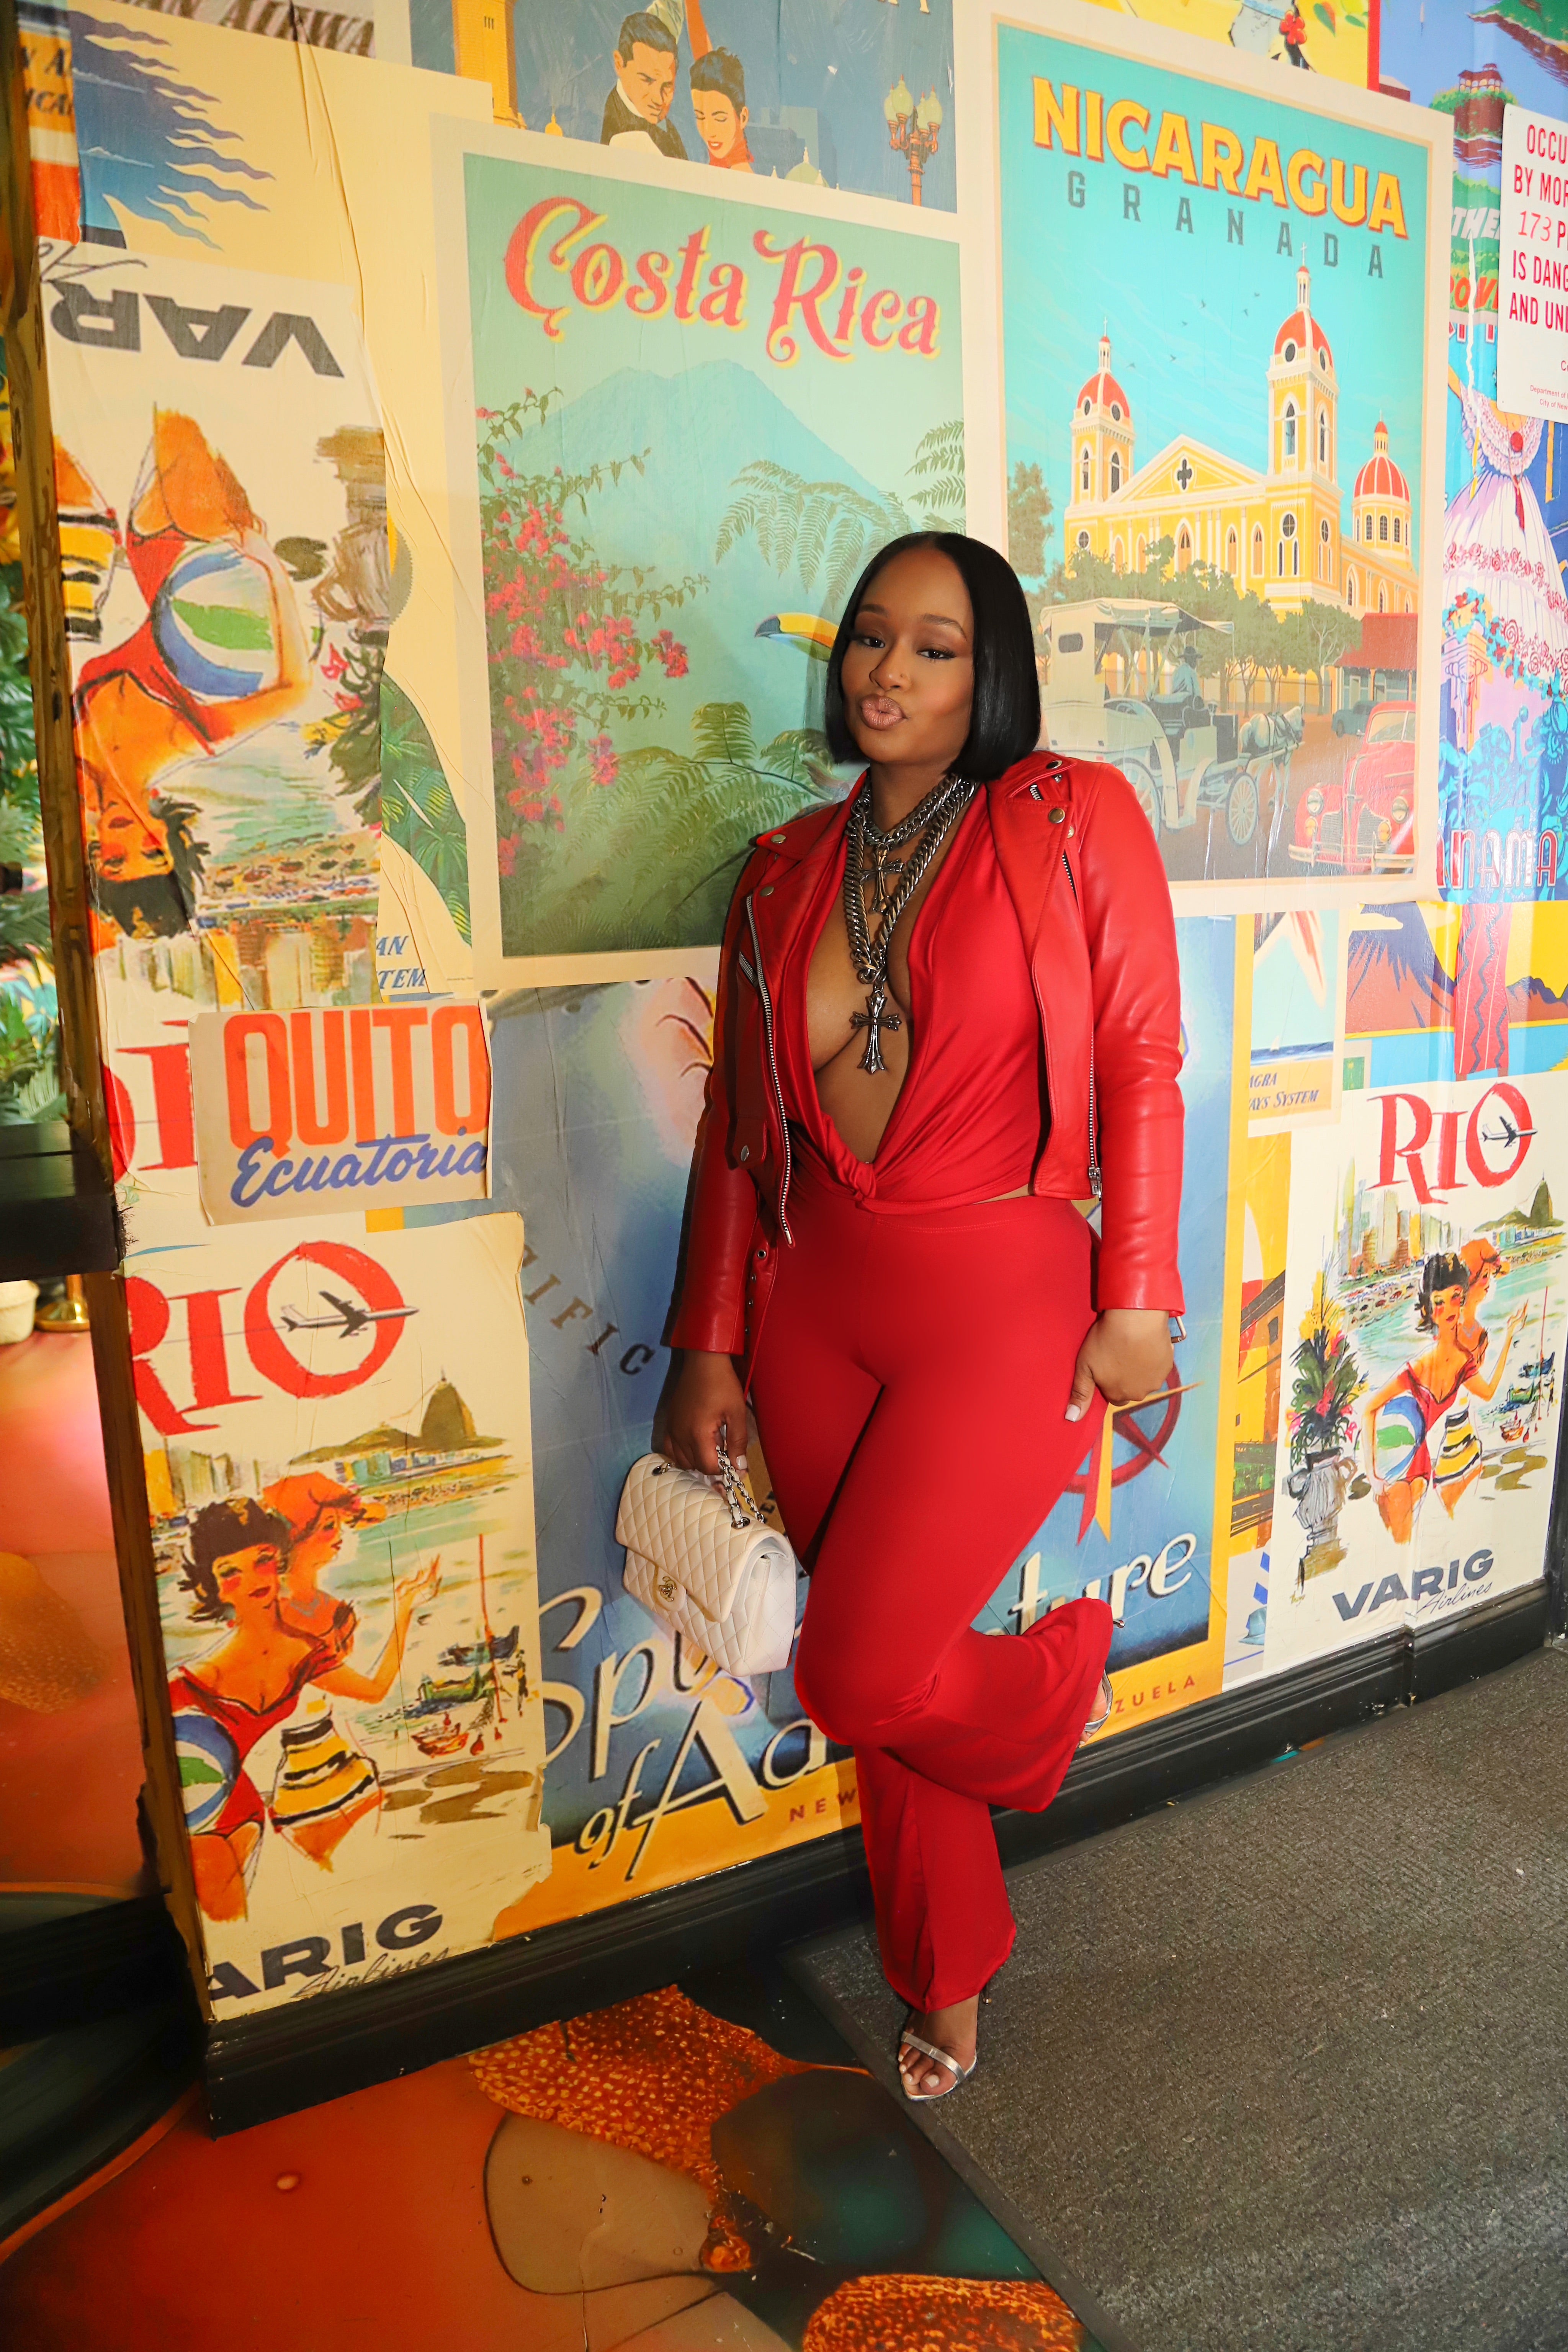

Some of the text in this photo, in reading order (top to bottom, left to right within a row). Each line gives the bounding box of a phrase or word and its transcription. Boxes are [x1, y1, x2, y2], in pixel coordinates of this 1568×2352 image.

[1031, 75, 1409, 240] NICARAGUA
[1527, 124, 1568, 164] OCCU
[1514, 164, 1533, 197] BY
[1068, 170, 1383, 279] GRANADA
[1518, 210, 1552, 242] 173
[1513, 250, 1526, 280] IS
[502, 195, 942, 369] Costa Rica
[1509, 292, 1539, 325] AND
[1530, 385, 1559, 397] Department
[1540, 399, 1549, 408] City
[1557, 402, 1568, 410] New
[376, 935, 409, 956] AN
[376, 968, 426, 989] TEM
[223, 1005, 488, 1160] QUITO
[1249, 1089, 1319, 1111] AYS SYSTEM
[1366, 1082, 1532, 1205] RIO
[1332, 1549, 1494, 1621] VARIG
[1416, 1581, 1493, 1615] Airlines
[790, 1789, 858, 1822] NEW
